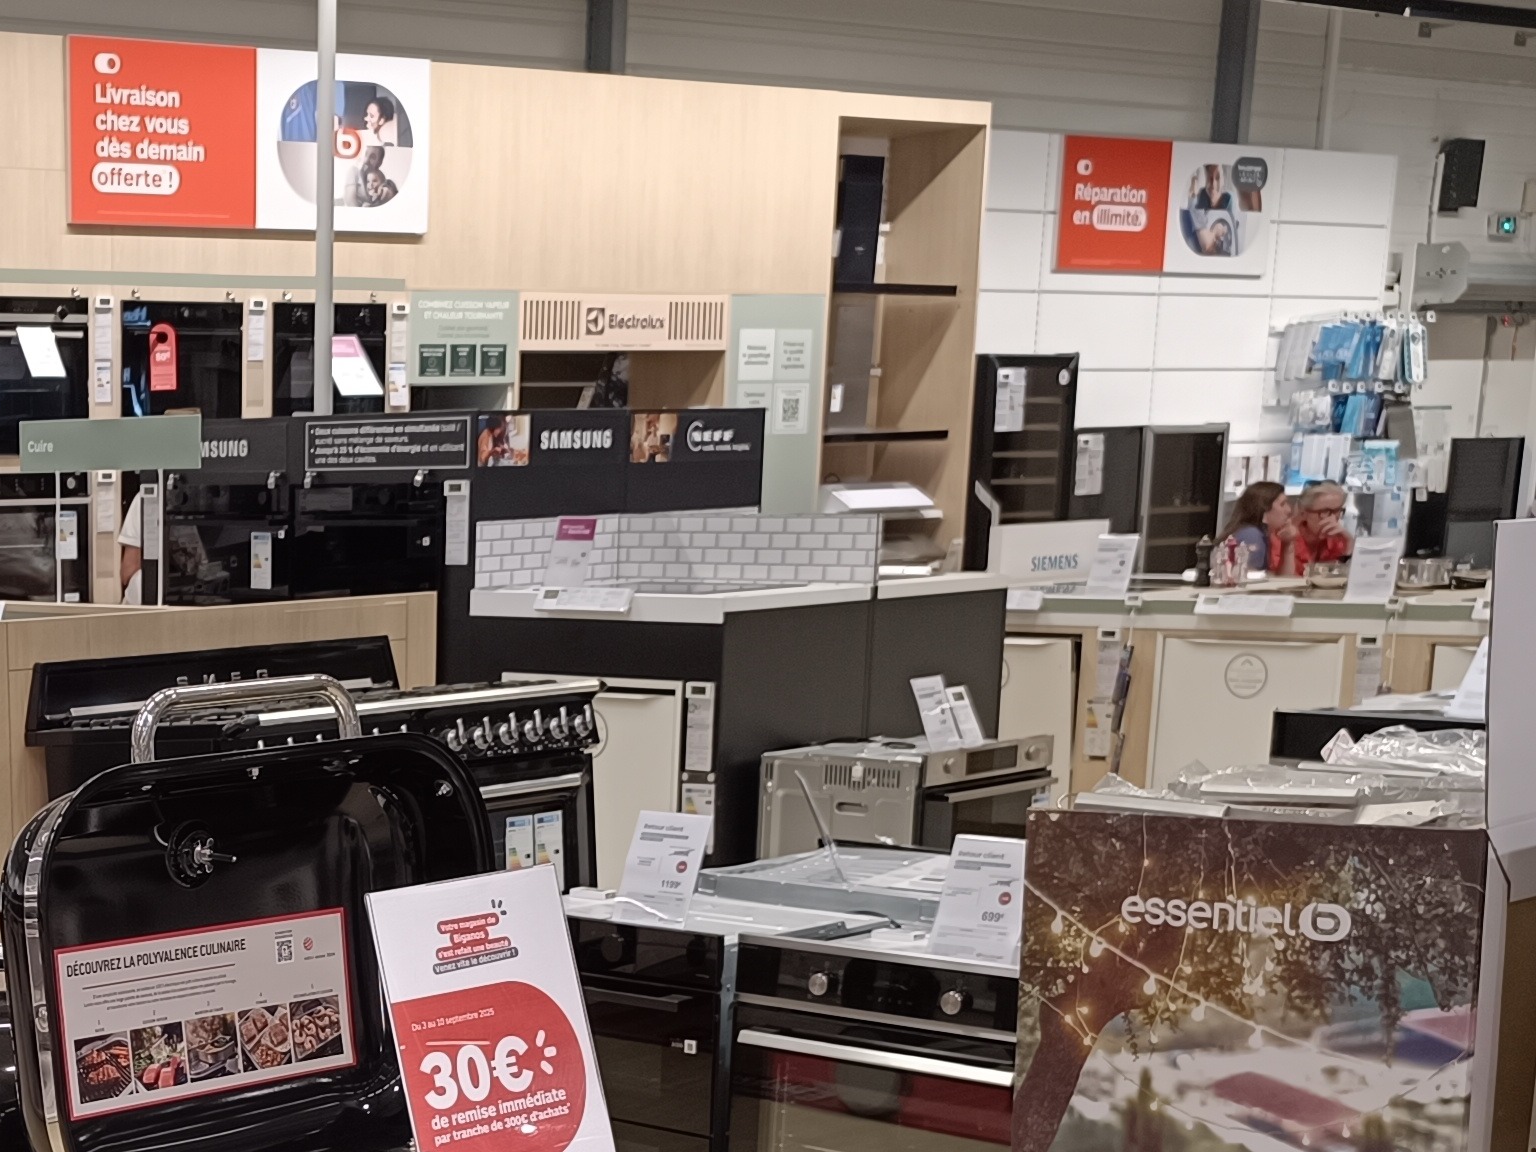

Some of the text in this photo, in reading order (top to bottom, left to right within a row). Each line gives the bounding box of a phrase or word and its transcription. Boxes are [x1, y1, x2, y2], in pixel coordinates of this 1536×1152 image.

[95, 83, 180, 108] Livraison
[95, 110, 189, 135] chez vous
[96, 136, 205, 163] dès demain
[97, 167, 162, 188] offerte
[1074, 182, 1146, 204] Réparation
[1073, 210, 1090, 225] en
[608, 313, 665, 329] Electrolux
[27, 440, 54, 453] Cuire
[200, 439, 249, 458] MSUNG
[540, 428, 613, 450] SAMSUNG
[1030, 553, 1079, 573] SIEMENS
[1121, 895, 1296, 937] essentiel
[67, 938, 246, 978] DÉCOUVREZ LA POLYVALENCE CULINAIRE
[445, 1010, 478, 1025] septembre
[419, 1035, 534, 1110] 30€
[431, 1087, 567, 1131] de remise immédiate
[434, 1133, 451, 1147] par
[452, 1123, 490, 1142] tranche
[491, 1119, 504, 1131] de
[504, 1113, 529, 1127] 300€
